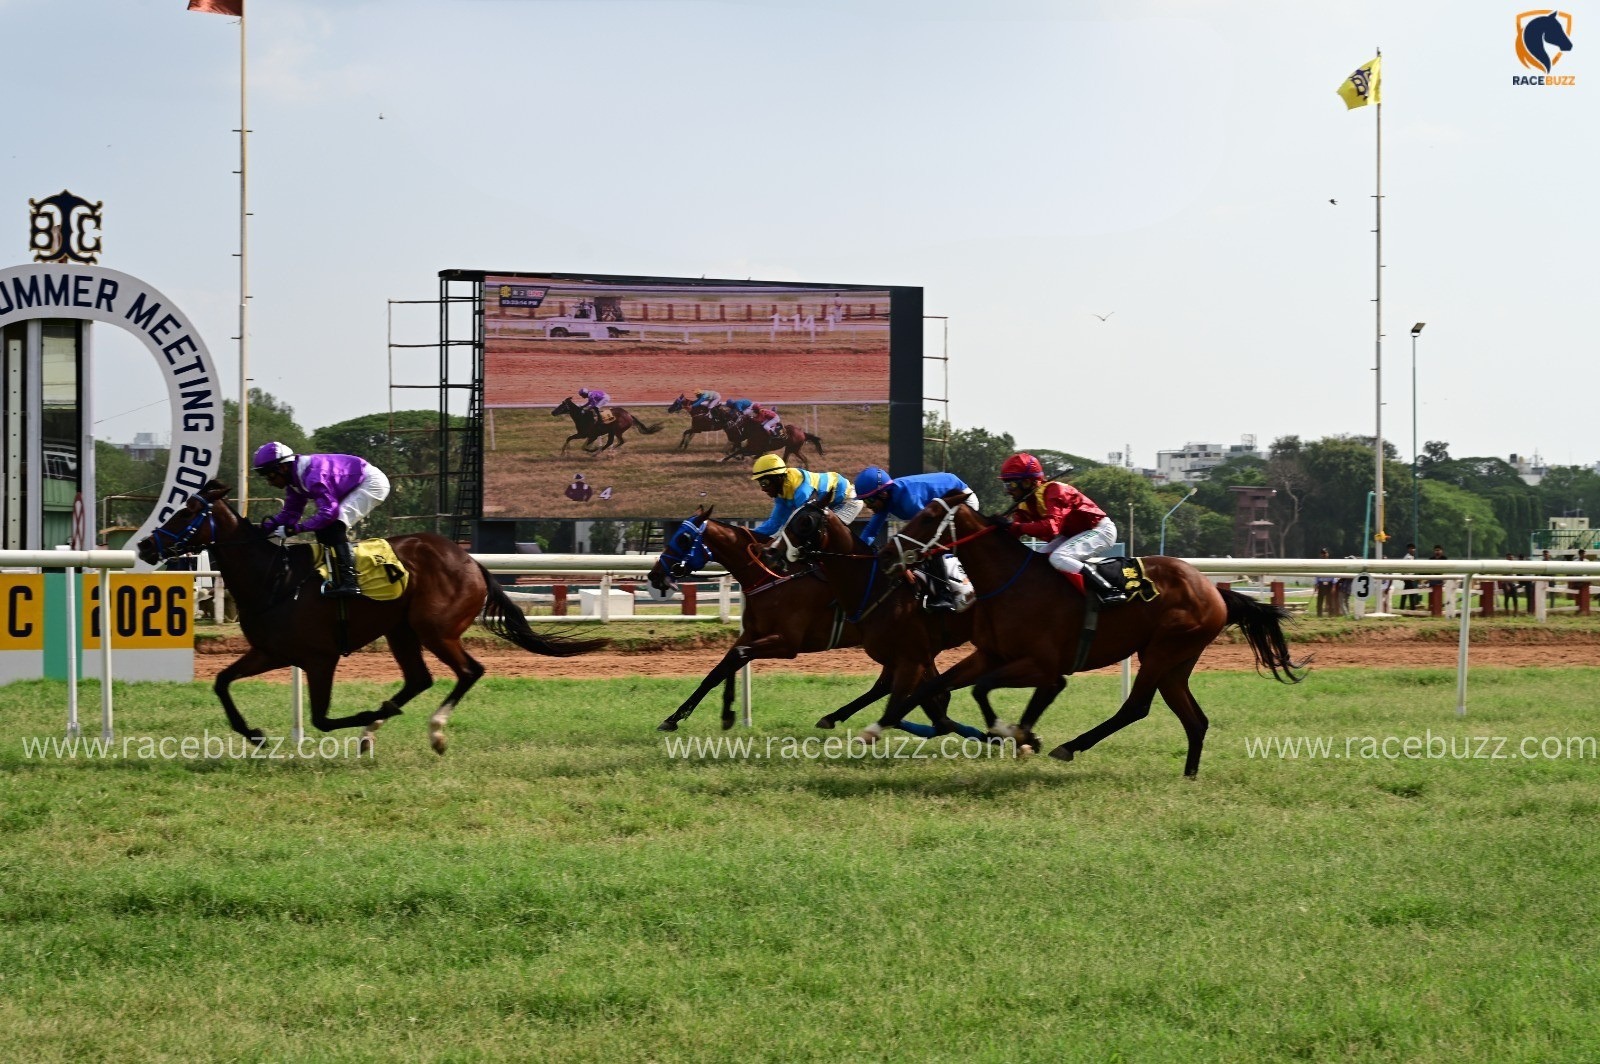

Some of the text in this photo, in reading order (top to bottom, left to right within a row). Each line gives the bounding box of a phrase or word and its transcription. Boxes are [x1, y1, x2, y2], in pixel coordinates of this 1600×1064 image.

[124, 292, 215, 432] MEETING
[599, 486, 612, 500] 4
[1357, 575, 1370, 598] 3
[8, 585, 33, 637] C
